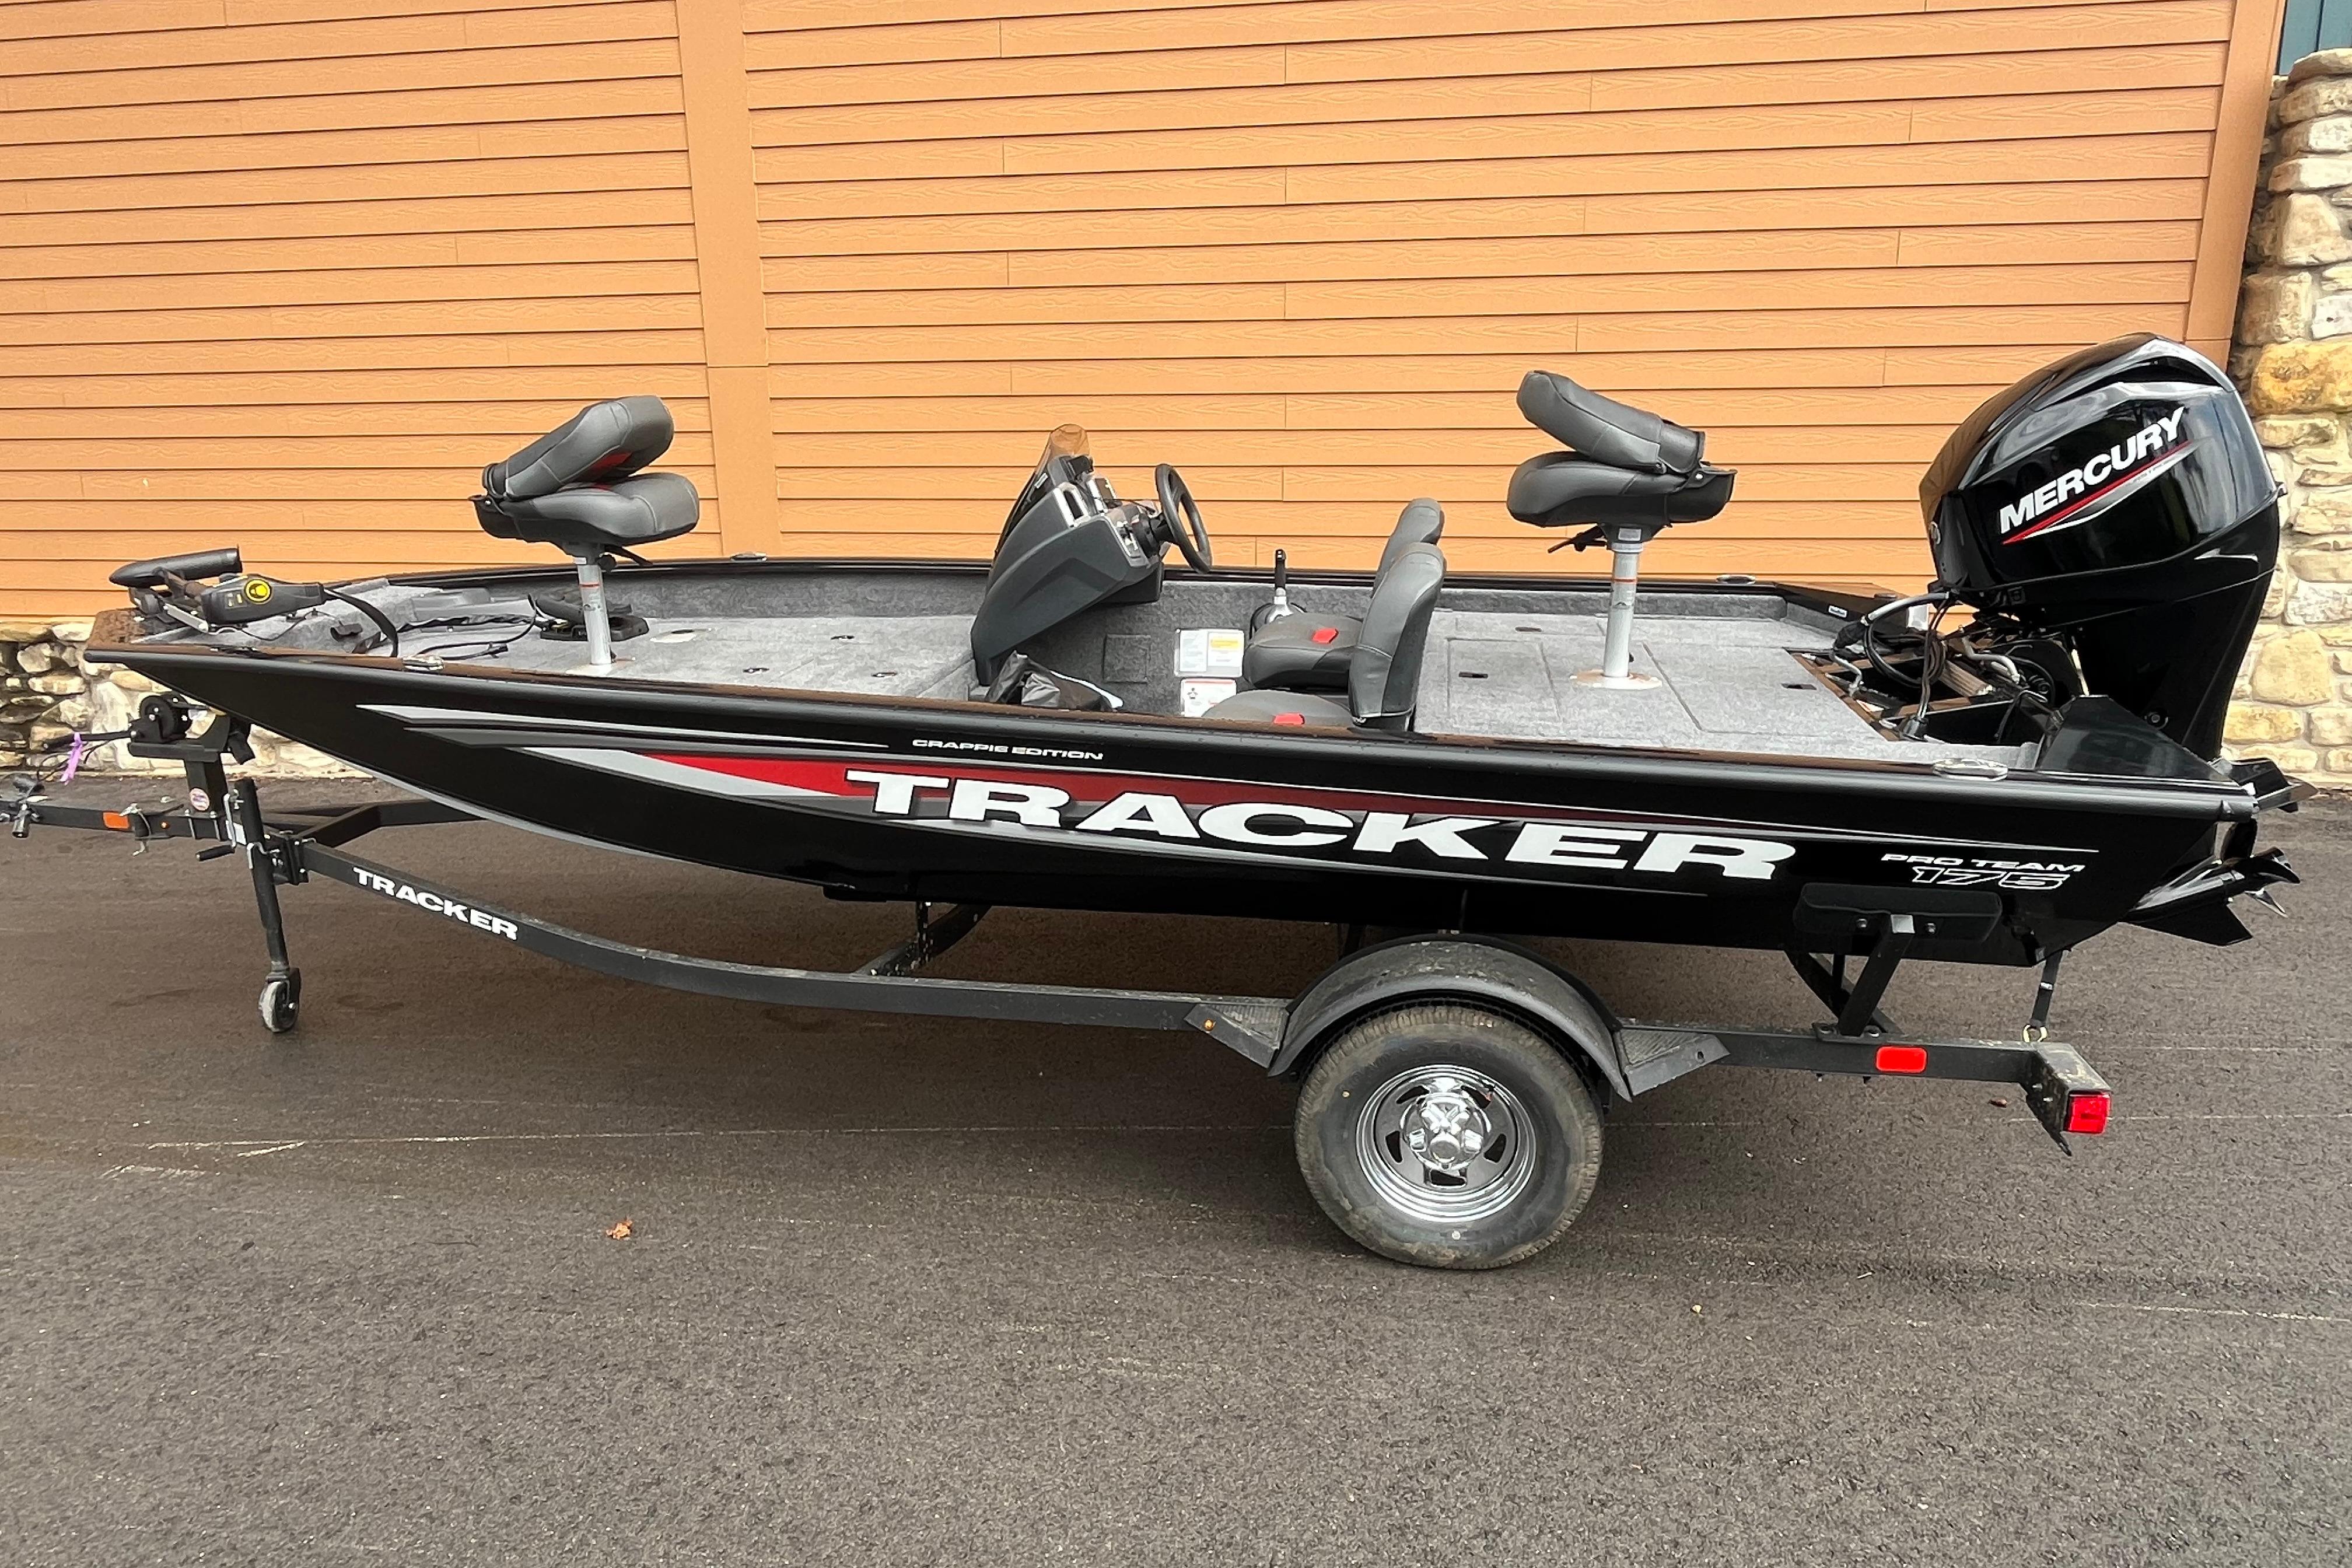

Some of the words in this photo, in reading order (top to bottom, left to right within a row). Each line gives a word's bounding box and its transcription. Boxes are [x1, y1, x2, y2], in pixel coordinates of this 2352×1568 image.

[1999, 407, 2185, 534] MERCURY
[912, 739, 1009, 752] CRAPPIE
[1012, 747, 1103, 760] EDITION
[846, 769, 1796, 880] TRACKER
[1881, 853, 1964, 865] PRO
[1971, 859, 2085, 872] TEAM
[1912, 866, 2070, 890] 175
[353, 867, 518, 940] TRACKER
